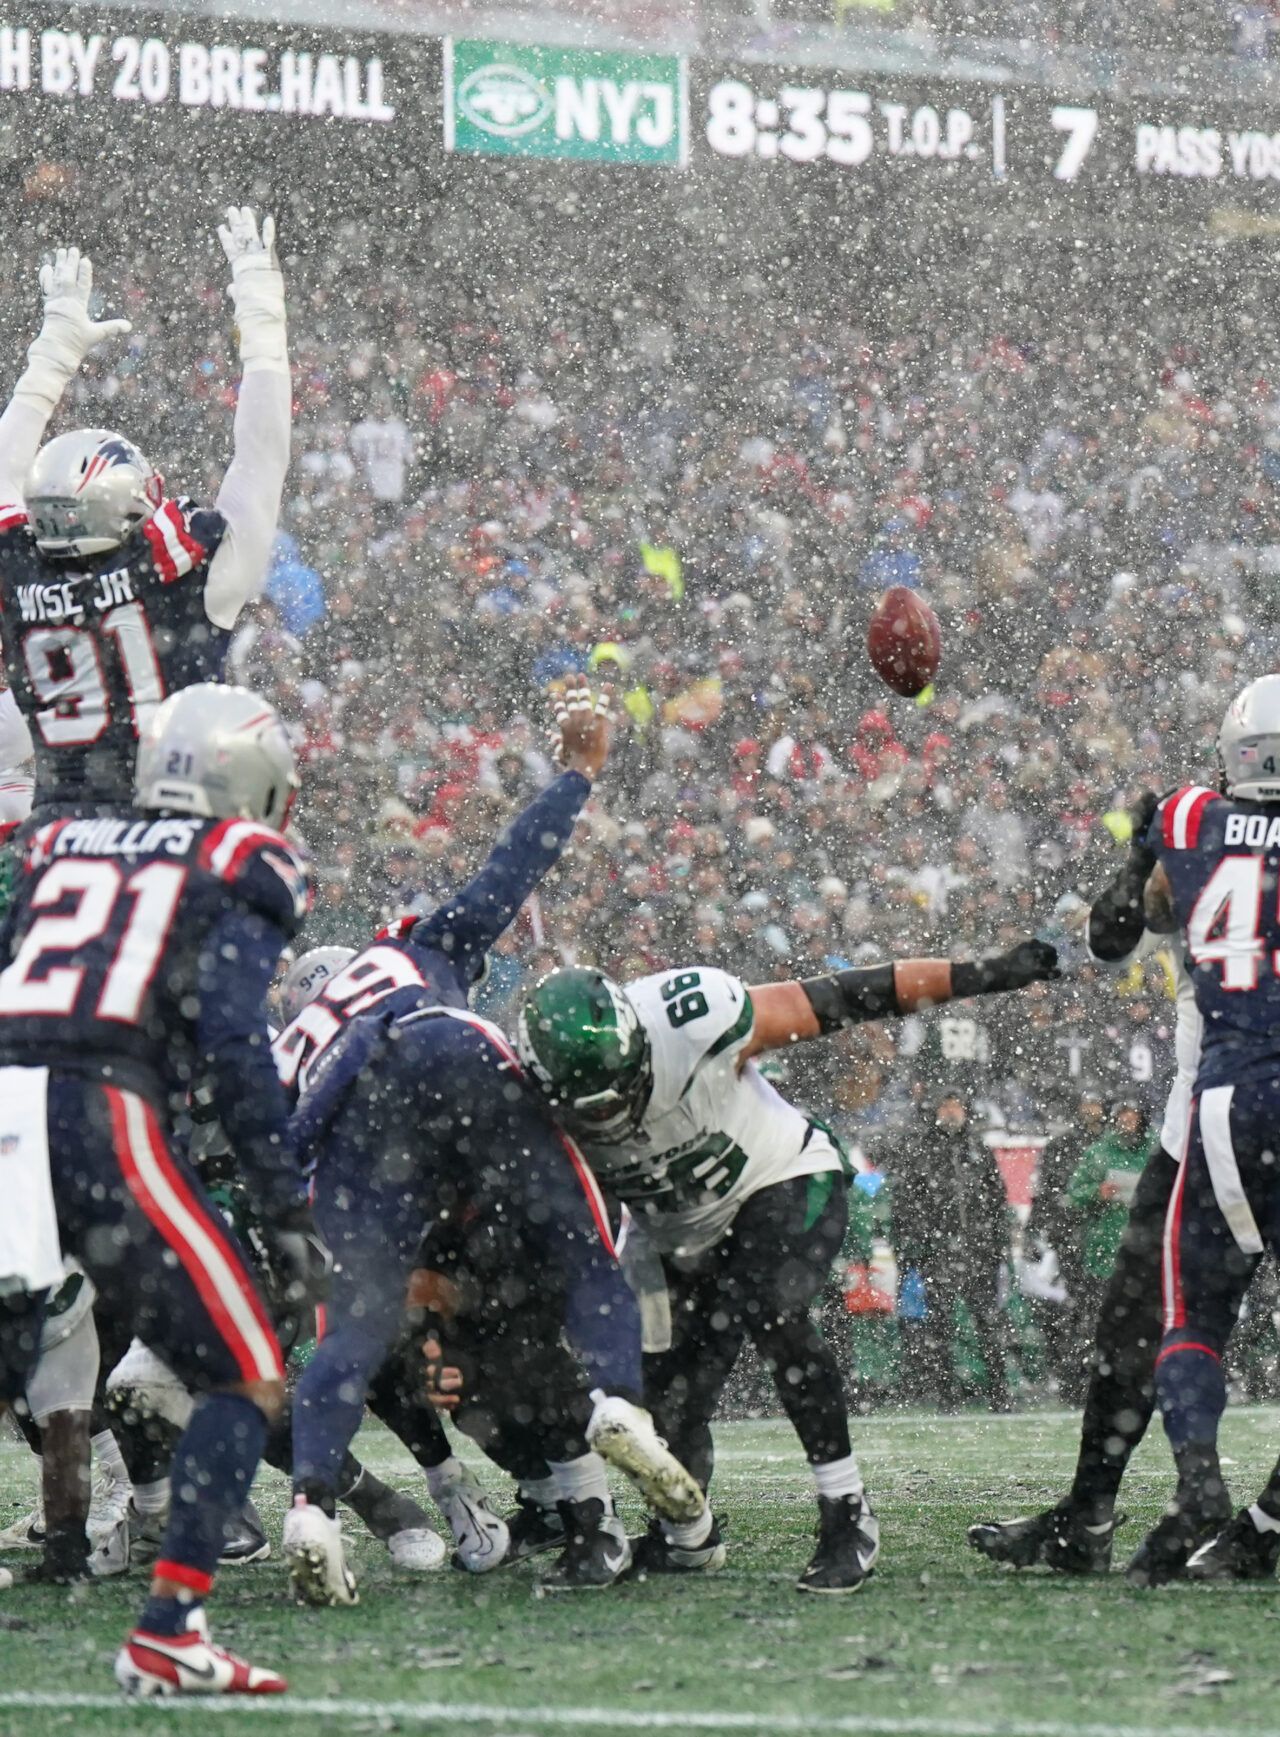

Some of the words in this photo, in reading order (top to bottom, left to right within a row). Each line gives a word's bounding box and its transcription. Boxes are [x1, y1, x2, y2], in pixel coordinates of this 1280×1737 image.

[41, 29, 102, 97] BY
[112, 36, 171, 103] 20
[555, 76, 676, 148] NYJ
[706, 79, 874, 165] 8:35
[882, 102, 982, 159] T.O.P.
[1051, 107, 1099, 180] 7
[1135, 124, 1222, 178] PASS
[17, 583, 84, 622] WISE
[94, 568, 134, 609] JR
[22, 601, 165, 745] 91
[166, 750, 193, 776] 21
[54, 818, 202, 855] PHILLIPS
[0, 858, 189, 1025] 21
[270, 946, 428, 1092] 99
